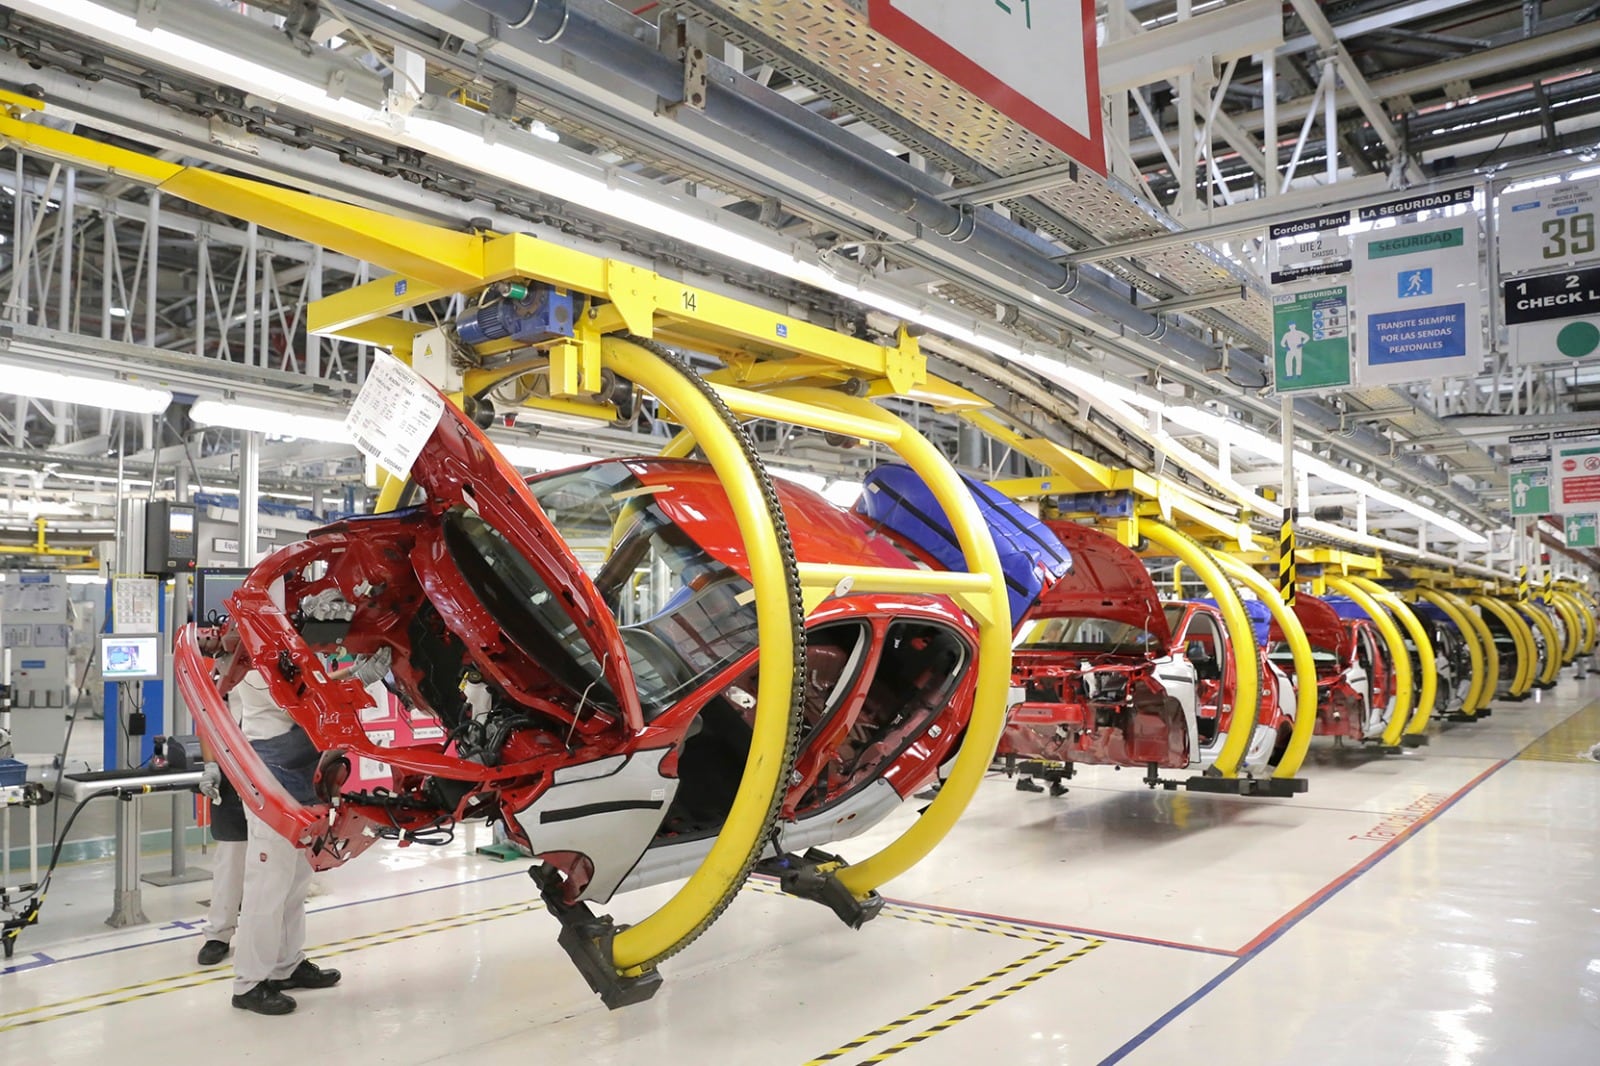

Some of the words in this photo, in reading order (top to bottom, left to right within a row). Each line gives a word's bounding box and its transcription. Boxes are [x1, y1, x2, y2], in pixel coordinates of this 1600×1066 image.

[1361, 209, 1377, 219] LA
[1380, 194, 1451, 215] SEGURIDAD
[1455, 190, 1471, 201] ES
[1273, 222, 1316, 236] Cordoba
[1319, 215, 1347, 227] Plant
[1378, 232, 1452, 252] SEGURIDAD
[1542, 212, 1595, 260] 39
[1300, 241, 1314, 253] UTE
[1316, 240, 1322, 250] 2
[1298, 288, 1343, 300] SEGURIDAD
[1516, 282, 1527, 296] 1
[1565, 274, 1580, 289] 2
[682, 291, 697, 312] 14
[1516, 290, 1583, 310] CHECK
[1376, 319, 1416, 331] TRANSITE
[1418, 314, 1457, 327] SIEMPRE
[1381, 334, 1399, 343] POR
[1400, 331, 1416, 341] LAS
[1417, 327, 1452, 339] SENDAS
[1389, 340, 1443, 354] PEATONALES
